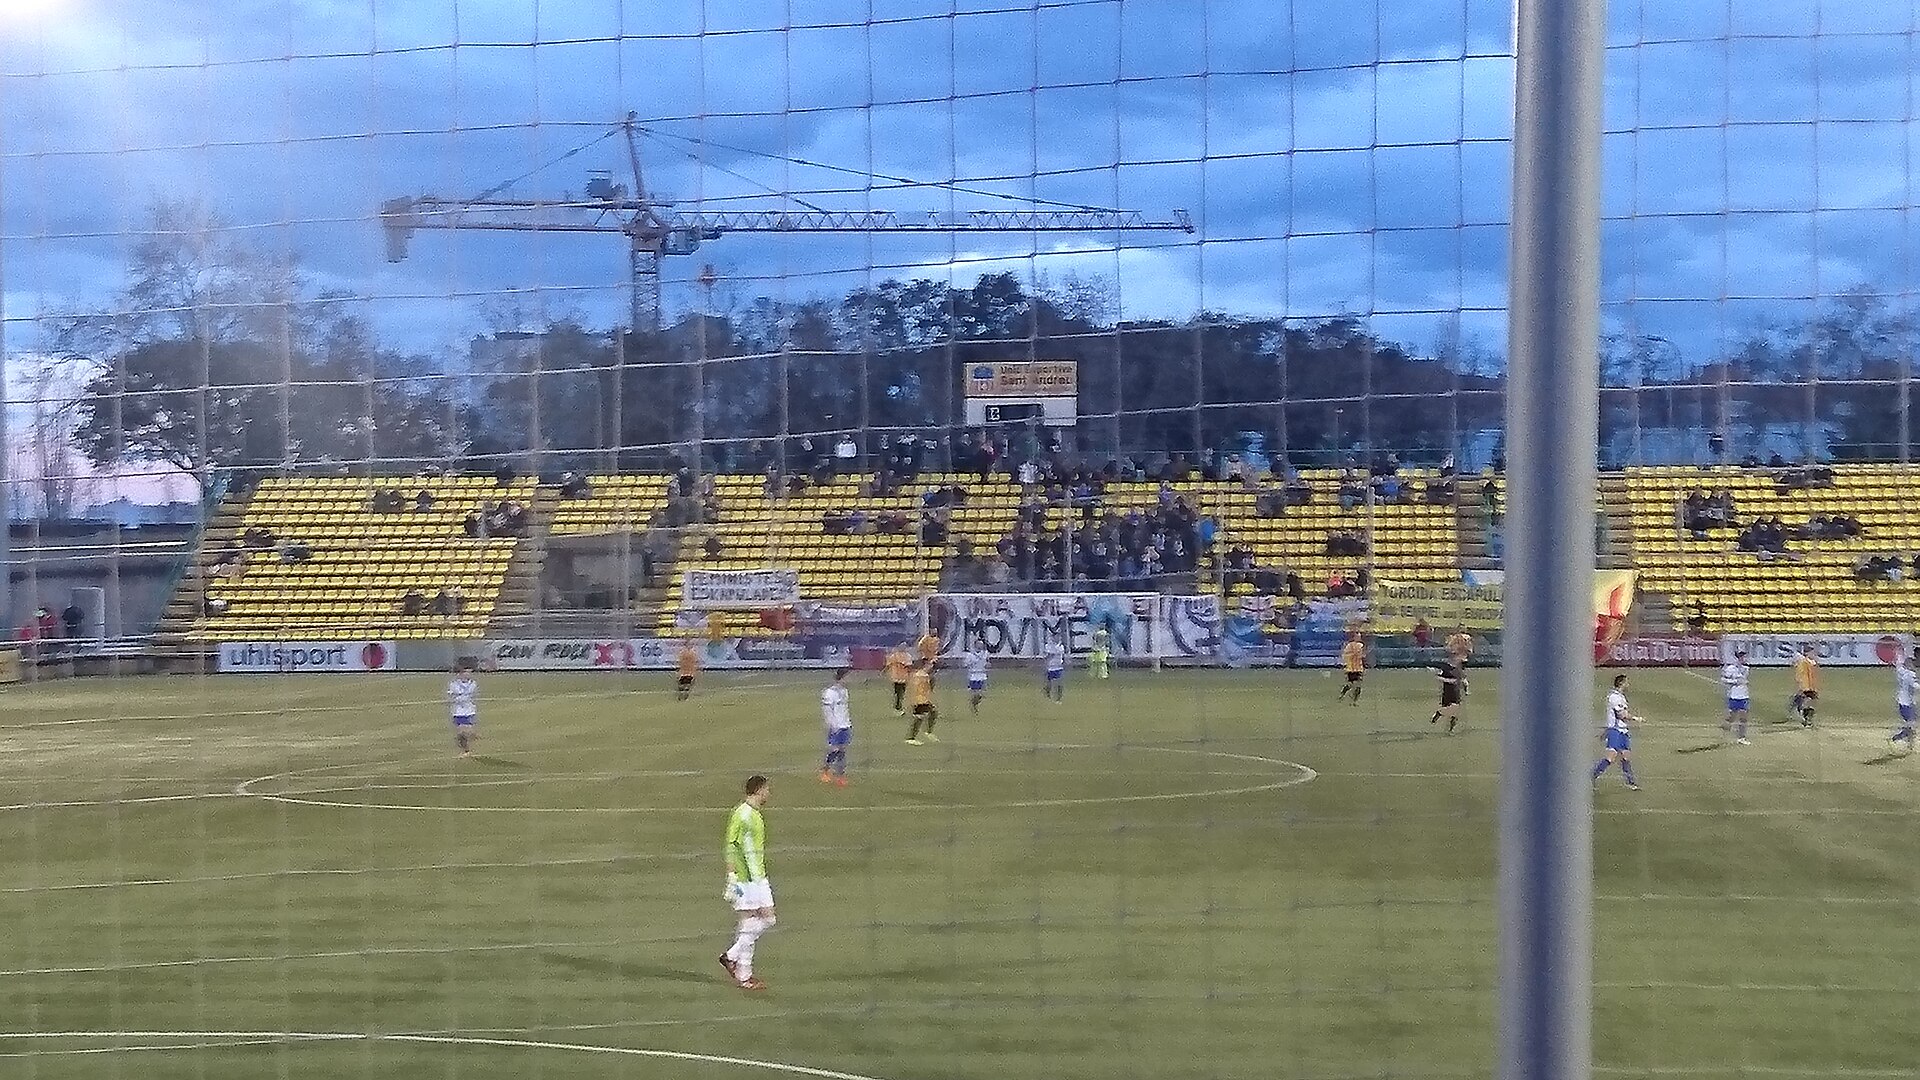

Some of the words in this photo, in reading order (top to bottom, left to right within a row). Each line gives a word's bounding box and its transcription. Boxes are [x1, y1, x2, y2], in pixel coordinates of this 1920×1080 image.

[1379, 584, 1437, 600] TORCIDA
[1441, 587, 1504, 603] ESCAPUL
[230, 643, 347, 669] uhlsport
